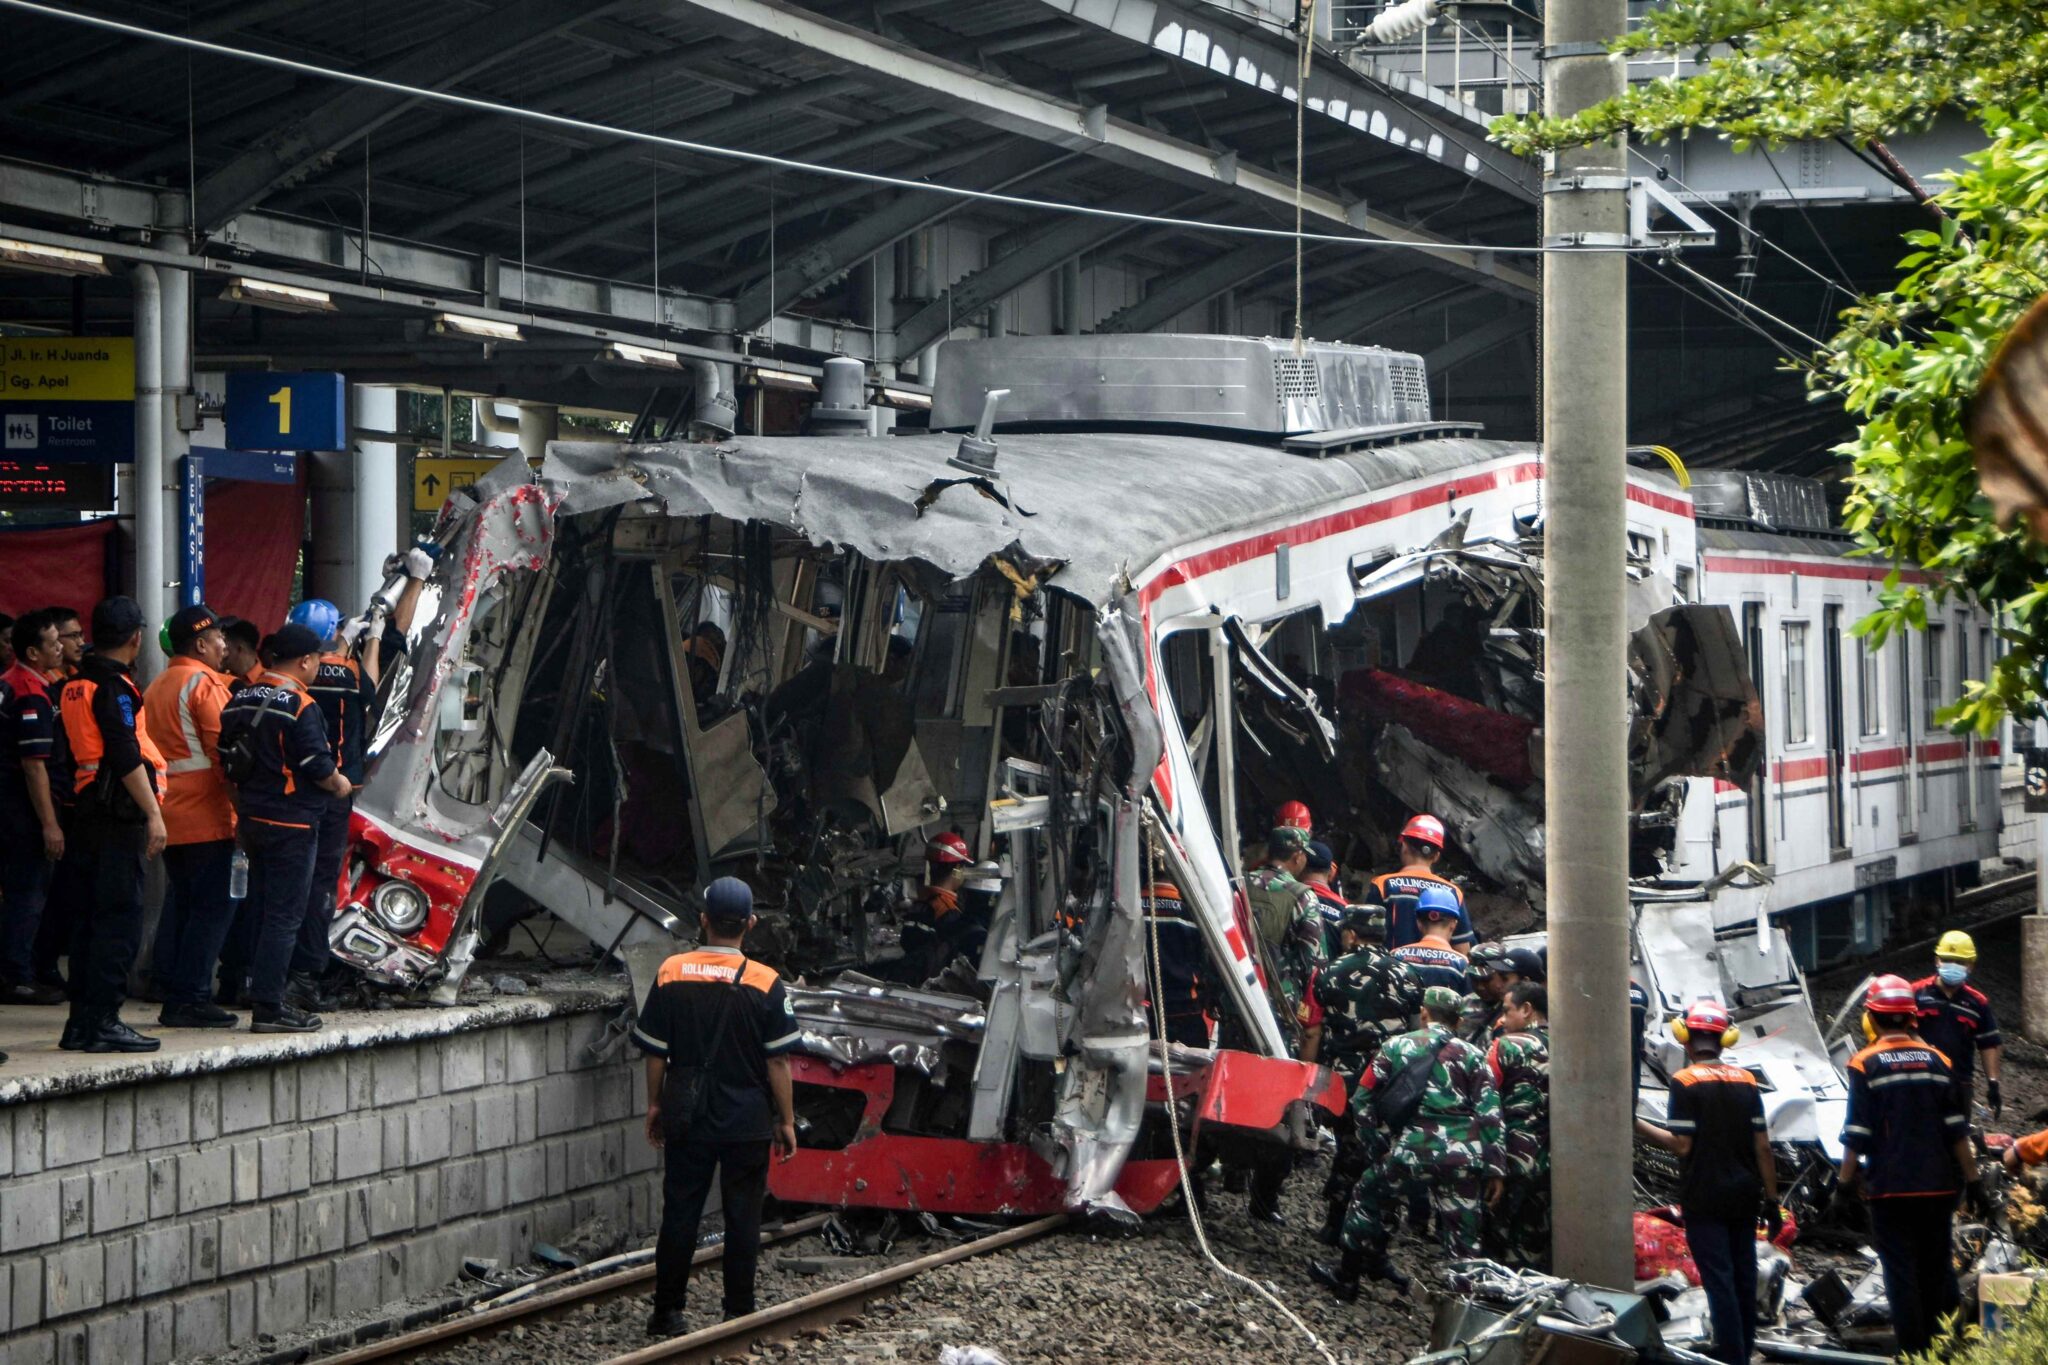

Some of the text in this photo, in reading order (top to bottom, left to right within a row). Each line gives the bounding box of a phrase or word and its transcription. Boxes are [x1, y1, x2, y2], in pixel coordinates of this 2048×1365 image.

[47, 349, 58, 360] H
[61, 349, 110, 361] Juanda
[10, 375, 69, 389] Gg. Apel
[268, 386, 291, 434] 1
[48, 416, 93, 431] Toilet
[47, 435, 96, 447] Restroom
[1878, 1051, 1933, 1063] ROLLINGSTOCK
